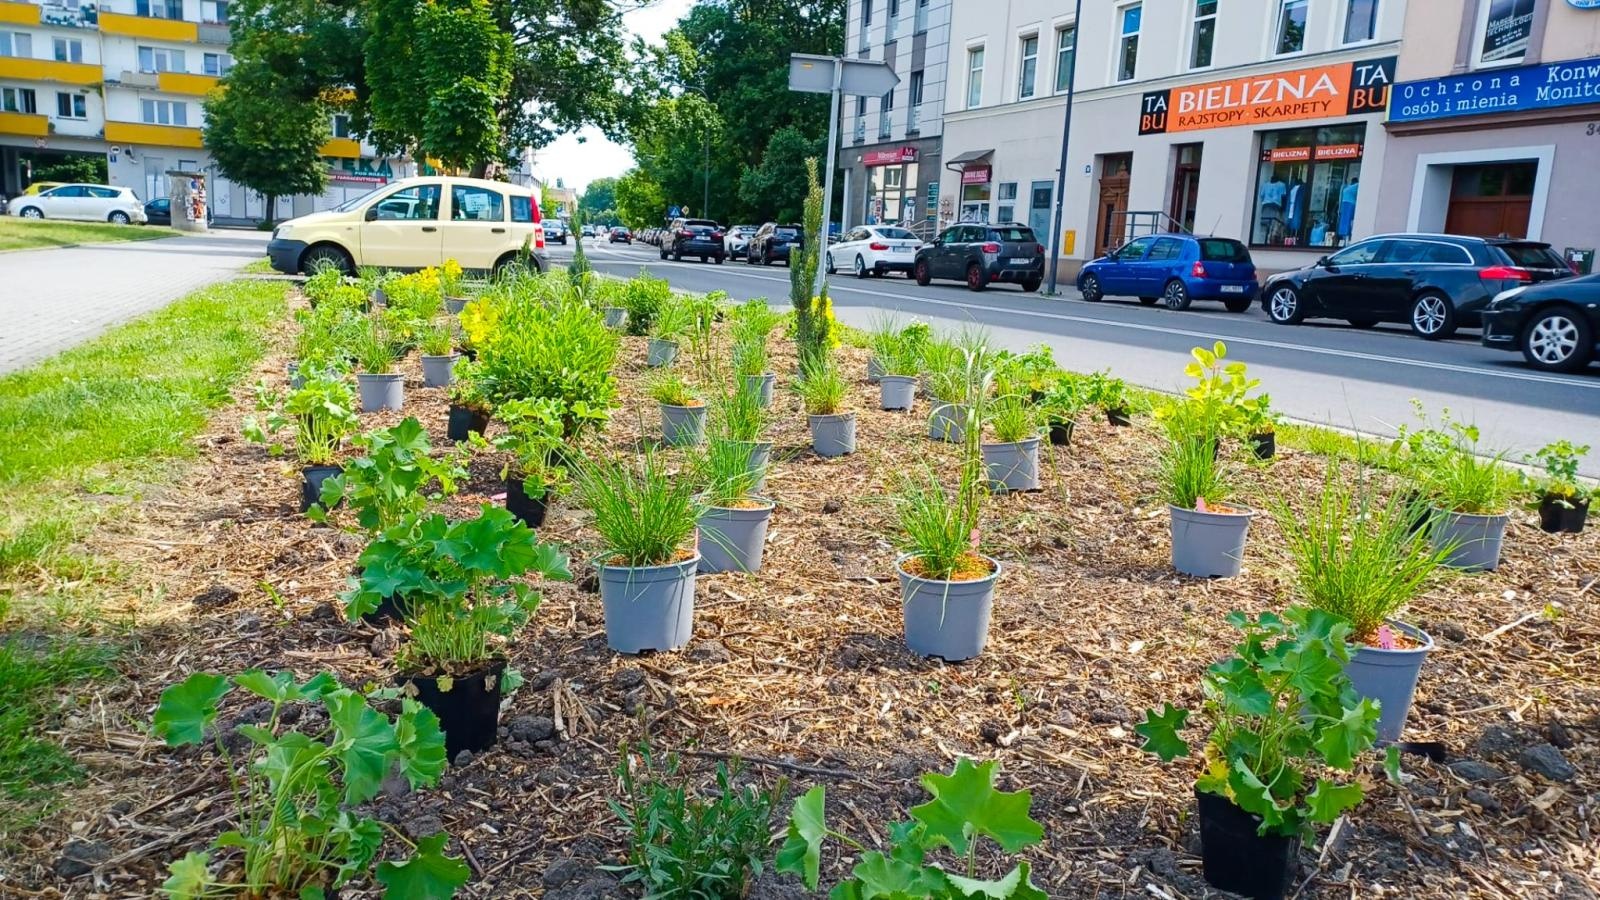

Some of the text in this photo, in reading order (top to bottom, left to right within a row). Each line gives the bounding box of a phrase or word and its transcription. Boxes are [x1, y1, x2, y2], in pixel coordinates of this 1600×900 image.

[1355, 64, 1389, 86] TA
[1144, 96, 1167, 113] TA
[1178, 73, 1338, 114] BIELIZNA
[1352, 86, 1388, 109] BU
[1402, 92, 1518, 116] osób i mienia
[1142, 113, 1165, 131] BU
[1178, 99, 1332, 127] RAJSTOPY SKARPETY
[1273, 150, 1308, 159] BIELIZNA
[1317, 147, 1356, 156] BIELIZNA
